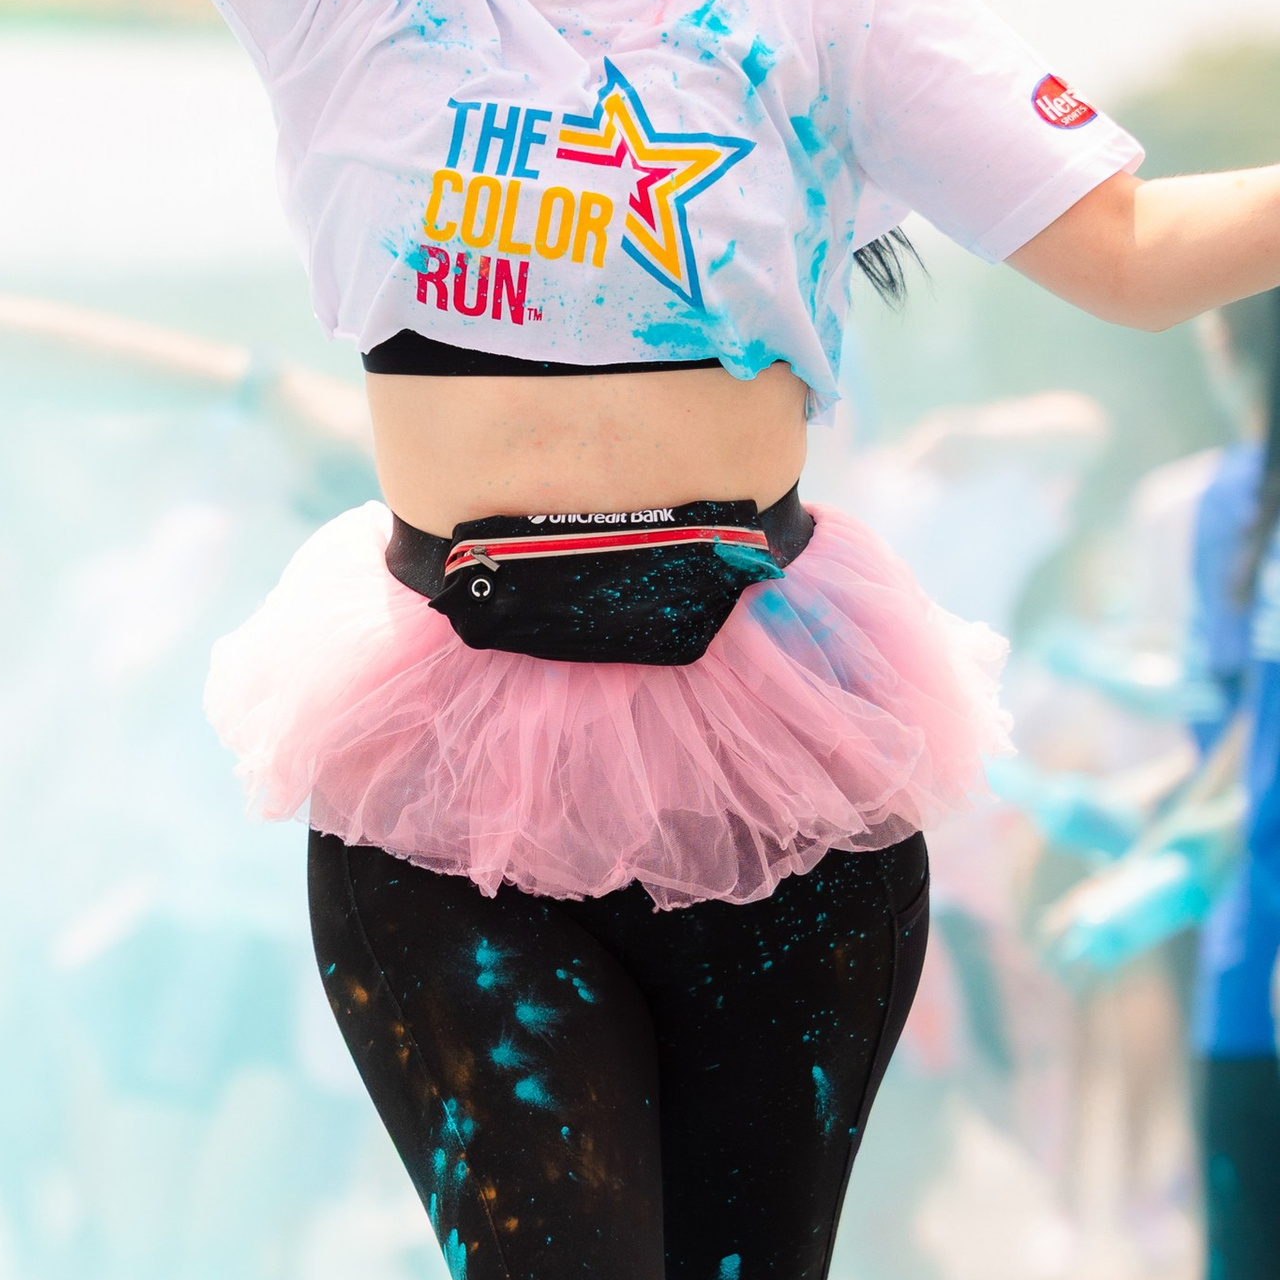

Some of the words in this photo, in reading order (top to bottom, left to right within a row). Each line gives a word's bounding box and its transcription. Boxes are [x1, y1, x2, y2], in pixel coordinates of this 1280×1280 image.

[446, 97, 553, 180] THE
[1060, 104, 1088, 127] SPORTS
[422, 168, 615, 269] COLOR
[415, 243, 531, 326] RUN
[630, 507, 676, 524] Bank
